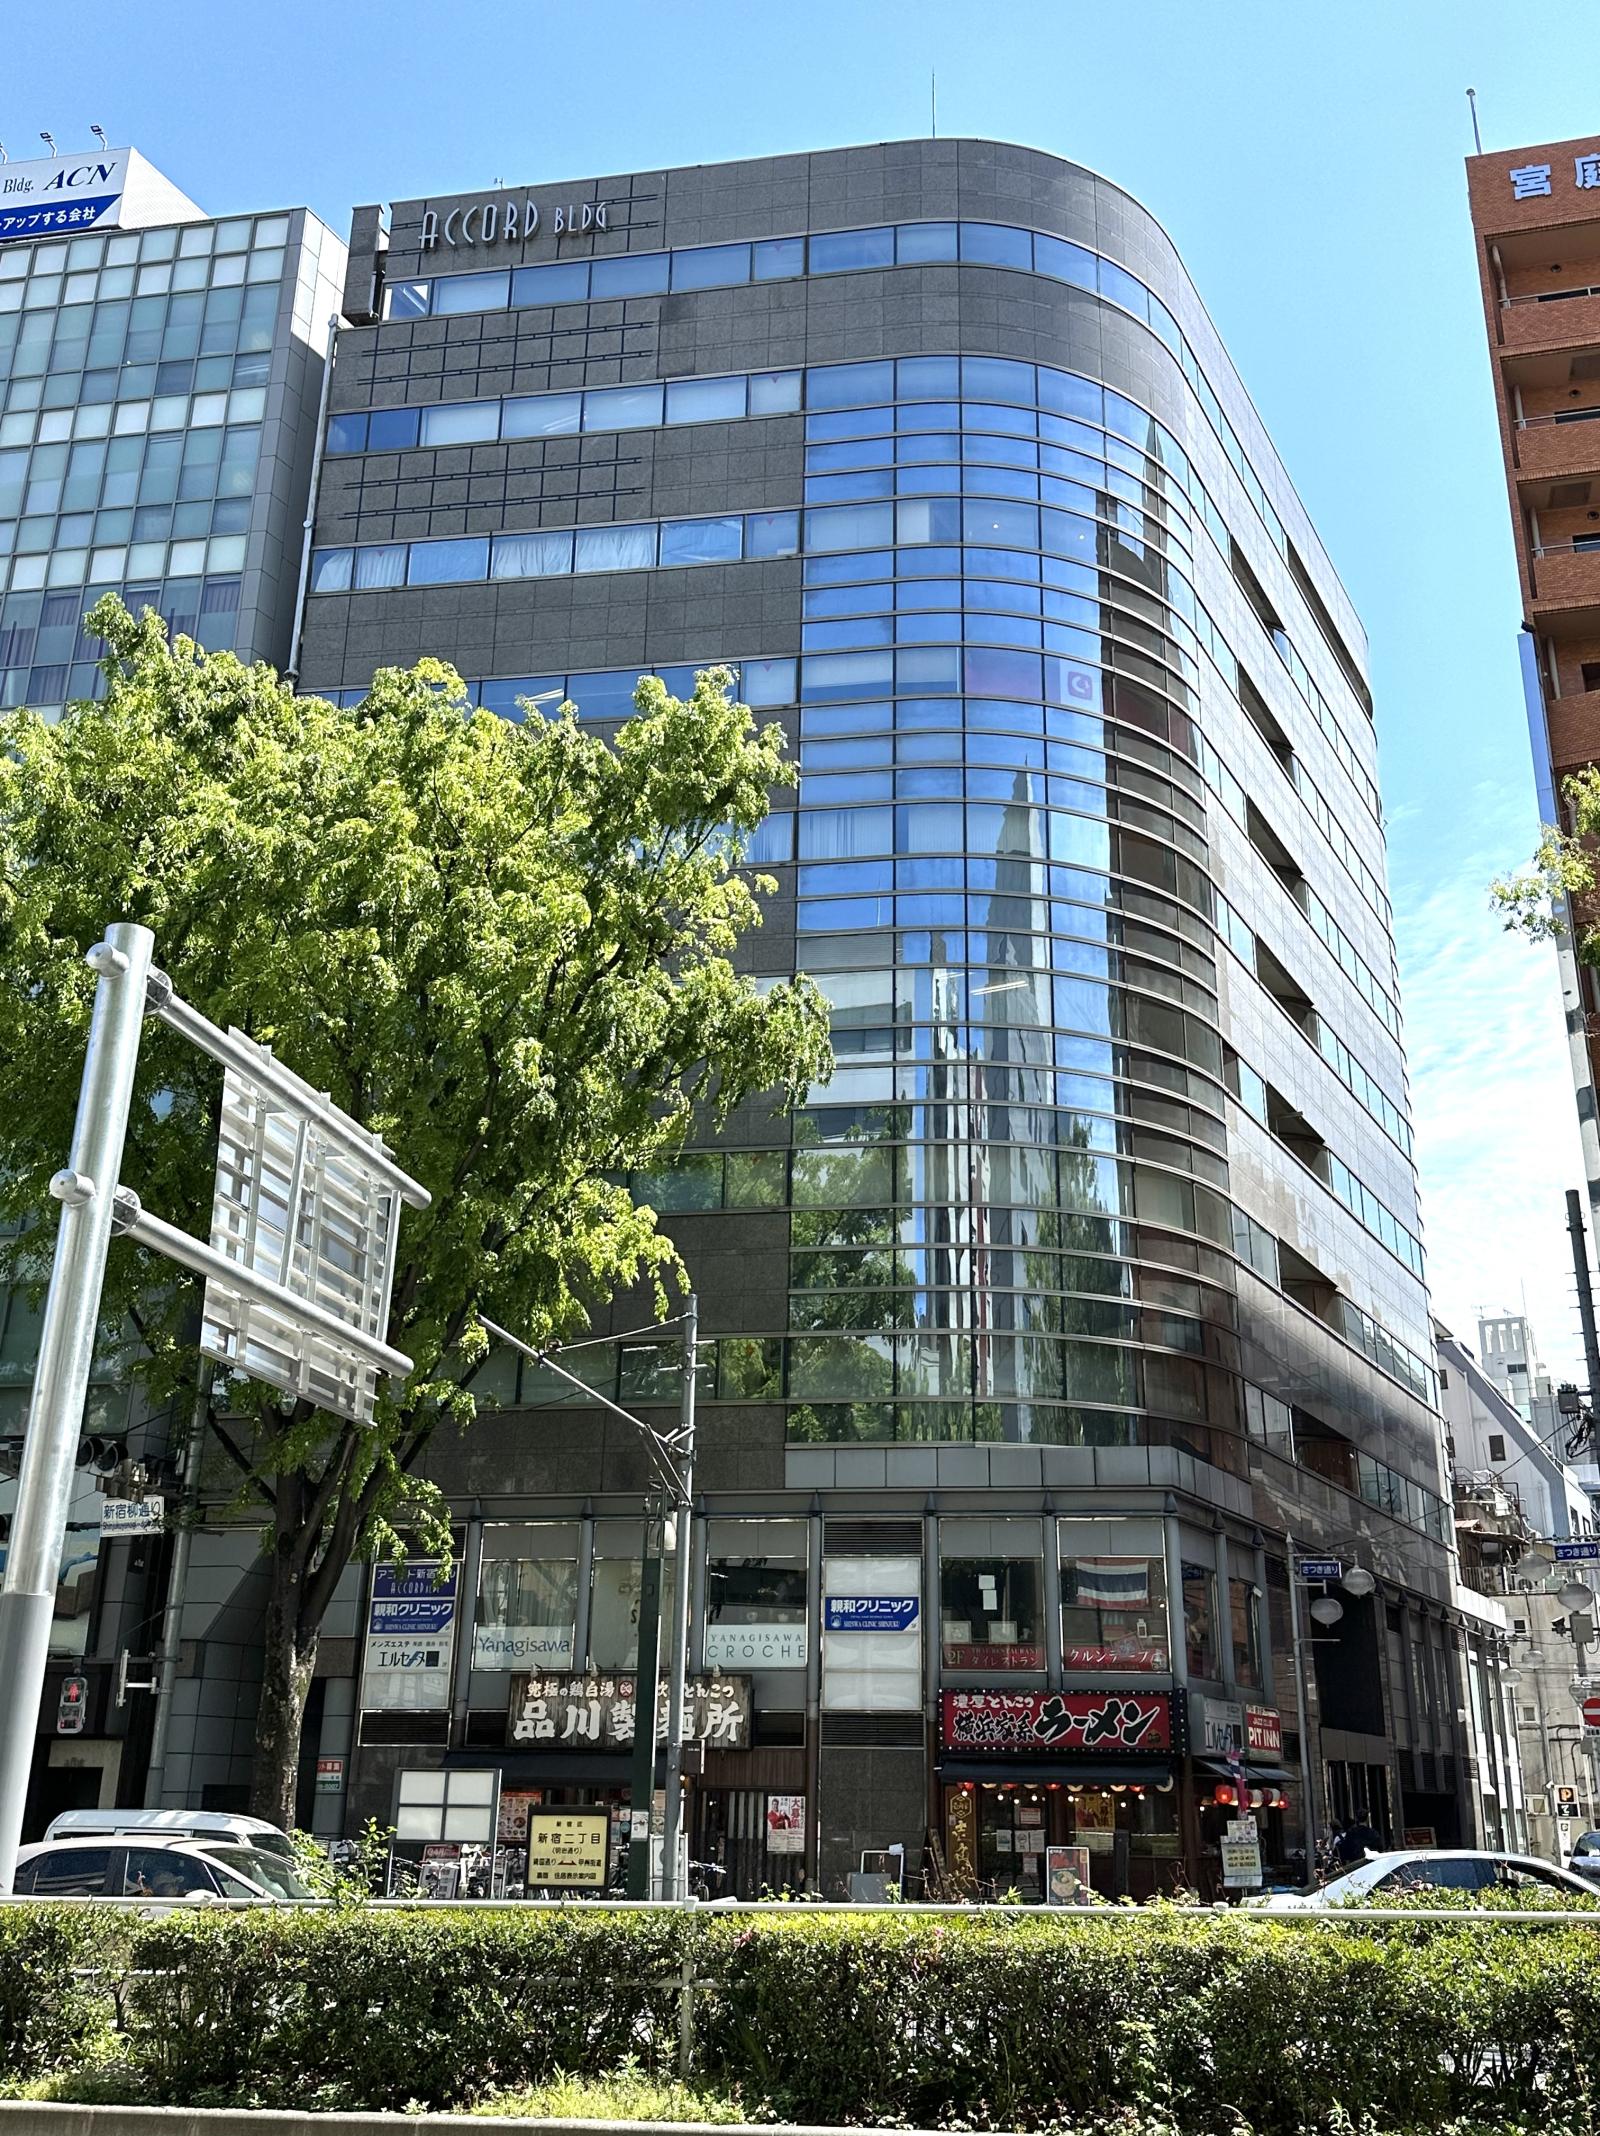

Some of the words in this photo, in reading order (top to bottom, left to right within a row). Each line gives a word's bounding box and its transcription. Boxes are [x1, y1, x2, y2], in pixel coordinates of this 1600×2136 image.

[3, 177, 34, 193] Bldg.
[42, 162, 118, 190] ACN
[0, 206, 96, 230] アップする会社
[418, 200, 539, 249] ACCORD
[555, 202, 606, 233] BLDG
[1557, 1547, 1596, 1557] さつき通り
[1302, 1566, 1337, 1574] さつき通り
[374, 1603, 453, 1616] 親和クリニック
[830, 1600, 913, 1613] 親和クリニック
[711, 1634, 802, 1642] YANAGISAWA
[479, 1637, 570, 1656] Yanagisawa
[708, 1645, 805, 1658] CROCHE
[948, 1650, 965, 1665] 2F
[971, 1656, 1040, 1667] タイレストラン
[527, 1681, 615, 1698] 究極の鶏白湯
[952, 1695, 1035, 1709] 濃厚とんこつ
[953, 1710, 1035, 1743] 横浜家系
[1033, 1696, 1161, 1745] ラーメン
[1248, 1726, 1262, 1746] PIT
[1263, 1729, 1280, 1748] INN
[538, 1833, 600, 1844] 新宿二丁目
